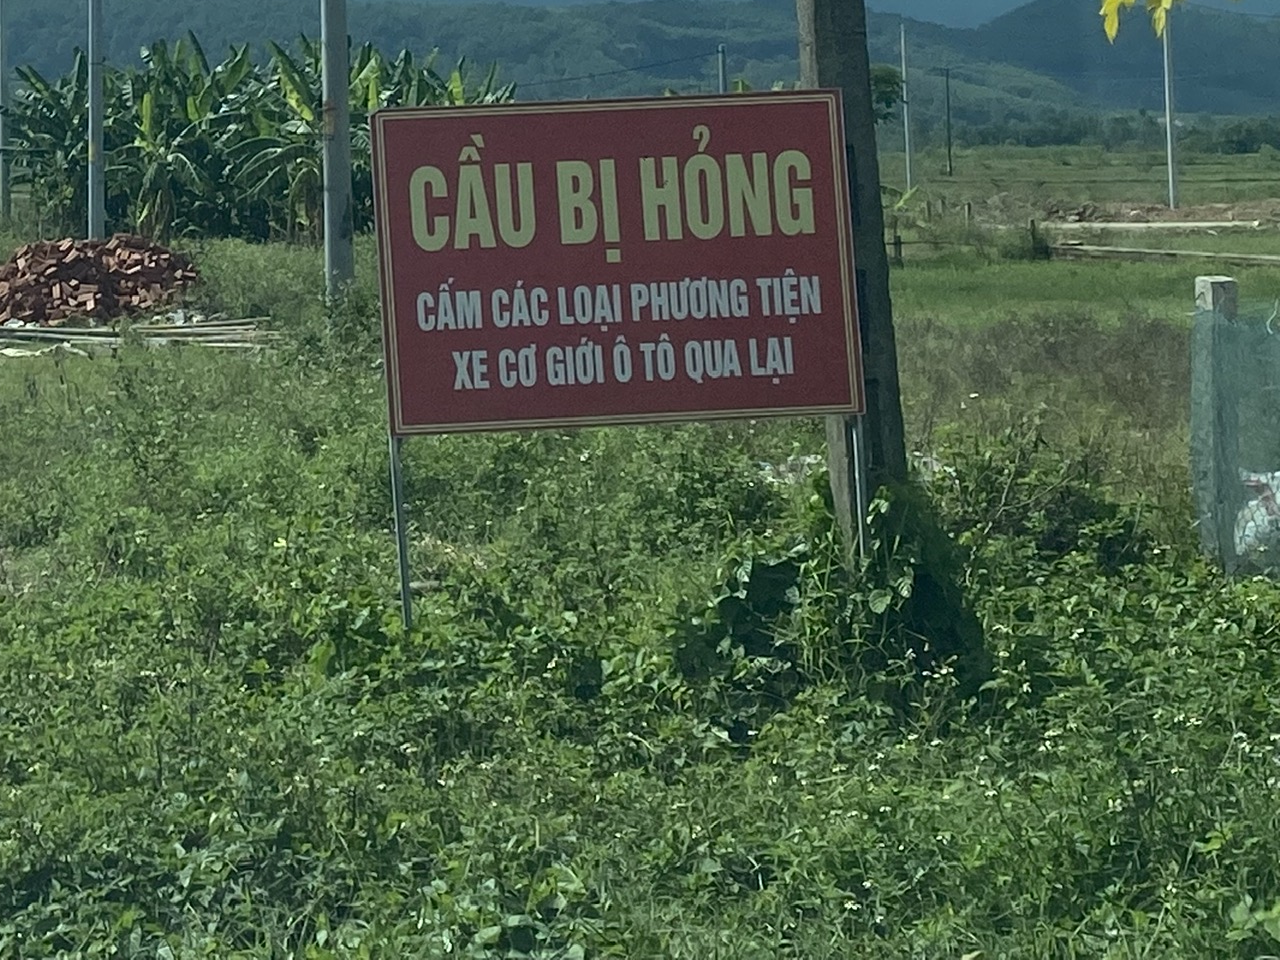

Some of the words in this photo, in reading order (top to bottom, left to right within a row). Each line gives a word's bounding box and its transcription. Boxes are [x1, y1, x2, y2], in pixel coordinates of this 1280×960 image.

[409, 134, 536, 252] CẦU
[556, 159, 621, 263] BỊ
[639, 125, 816, 241] HỎNG
[416, 278, 483, 331] CẤM
[491, 280, 550, 328] CÁC
[557, 284, 622, 332] LOẠI
[630, 276, 749, 323] PHƯƠNG
[756, 268, 822, 325] TIỆN
[452, 350, 490, 390] XE
[498, 343, 537, 388] CƠ
[546, 336, 605, 386] GIỚI
[613, 335, 632, 383] Ô
[639, 333, 676, 381] TÔ
[684, 339, 742, 384] QUA
[749, 336, 795, 384] LẠI
